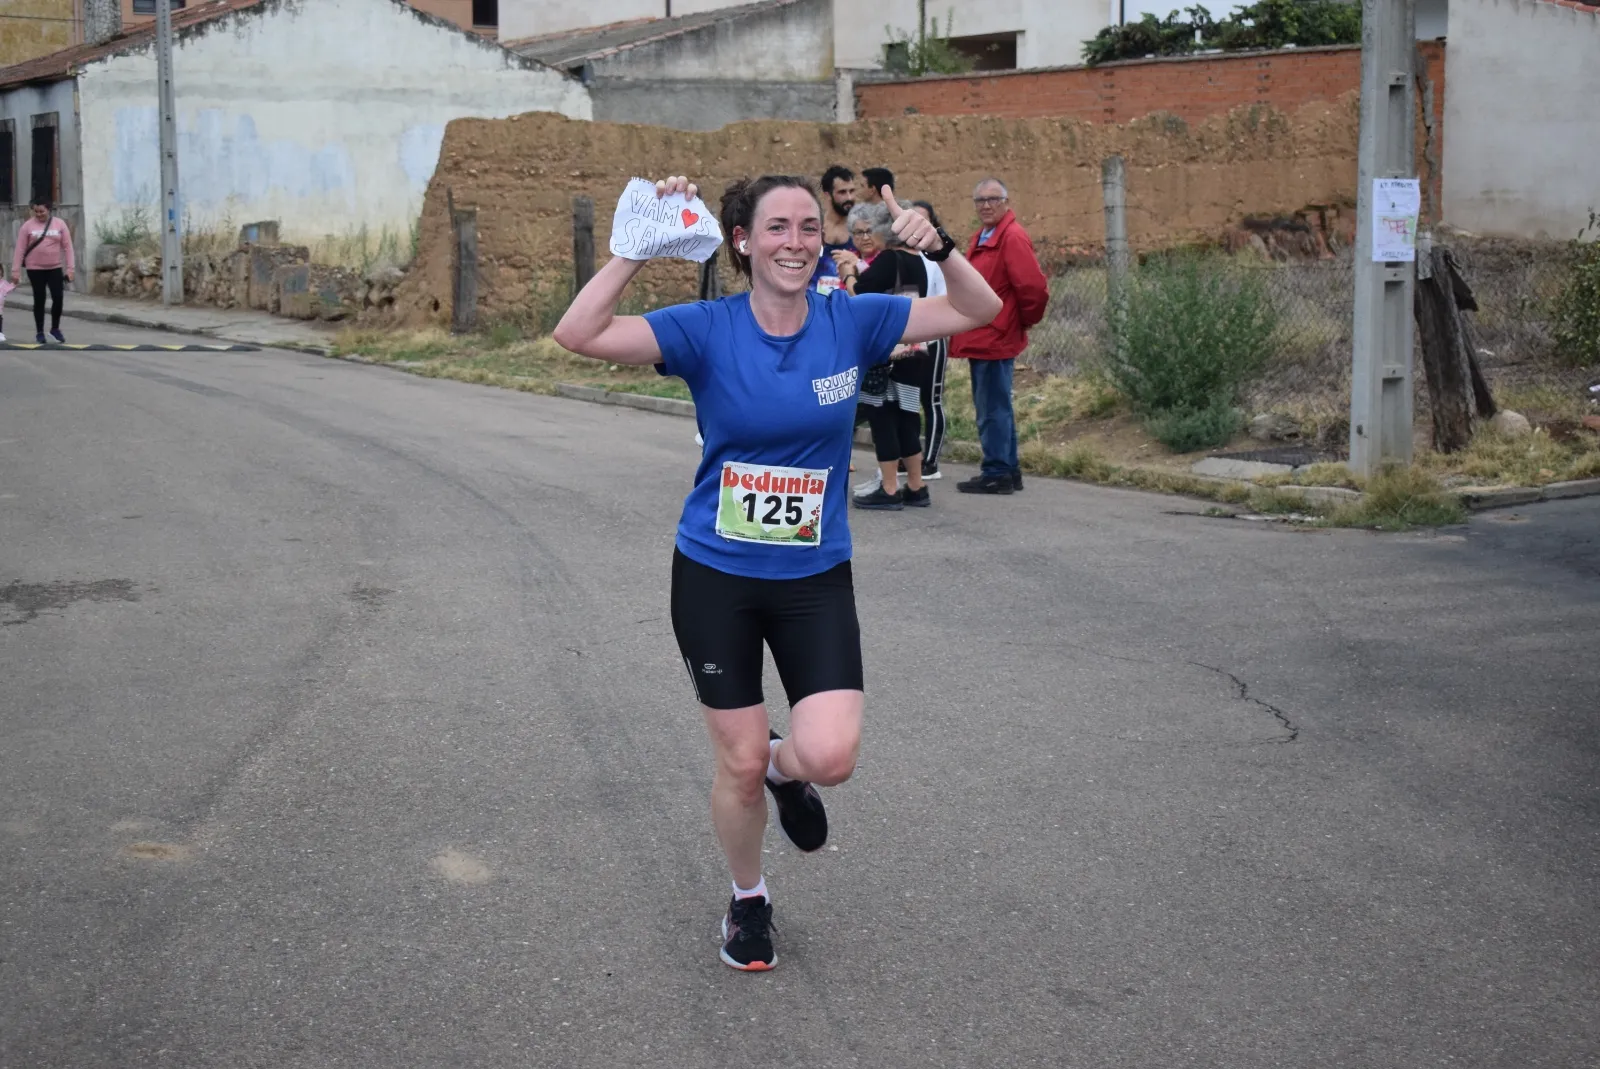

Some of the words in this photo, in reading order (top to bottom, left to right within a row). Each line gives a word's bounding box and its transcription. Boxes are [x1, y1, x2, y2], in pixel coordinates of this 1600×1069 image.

[614, 217, 701, 256] SAMU
[813, 367, 858, 391] EQUIPO
[723, 466, 824, 494] bedunia
[742, 493, 803, 525] 125
